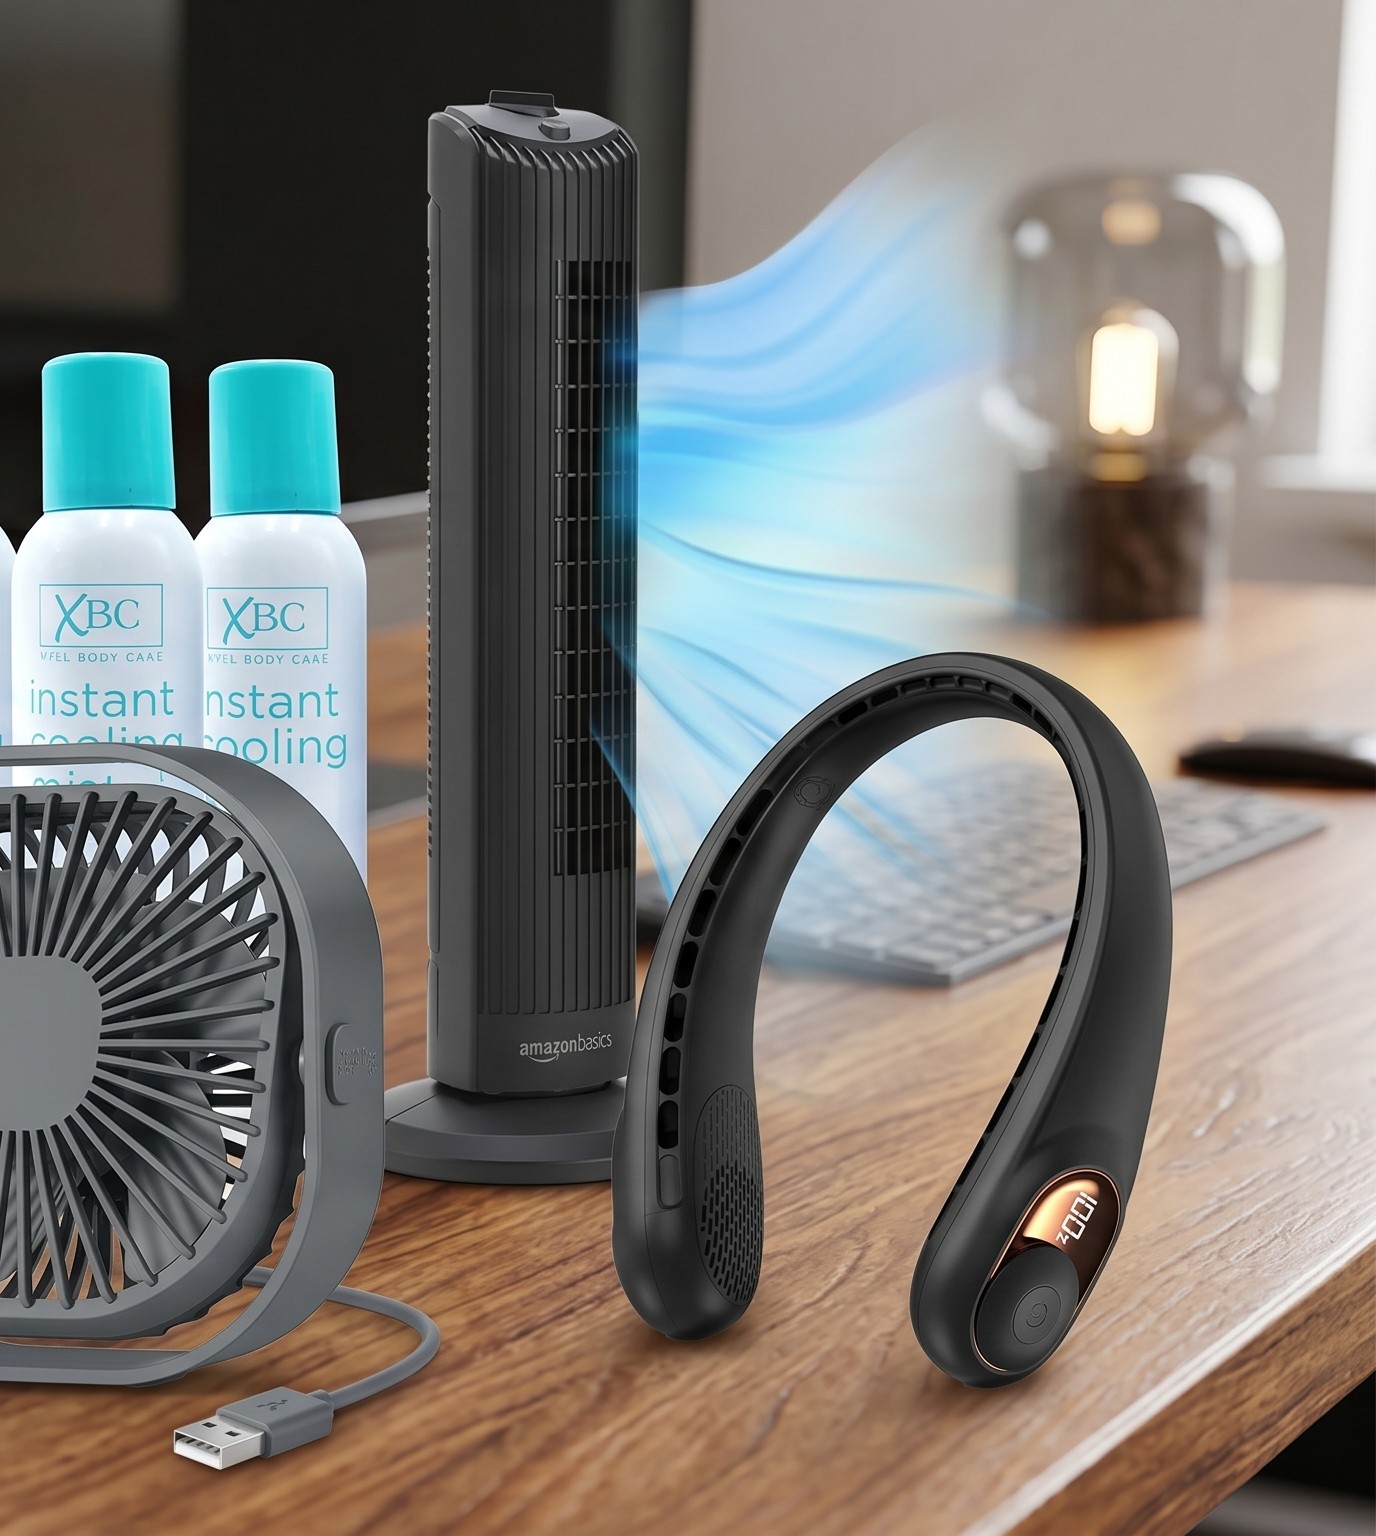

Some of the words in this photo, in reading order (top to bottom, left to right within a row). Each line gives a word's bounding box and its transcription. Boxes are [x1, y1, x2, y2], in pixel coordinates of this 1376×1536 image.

[54, 593, 140, 643] XBC
[222, 596, 305, 646] XBC
[78, 652, 118, 663] BODY
[244, 654, 284, 665] BODY
[30, 679, 174, 718] instant
[206, 683, 339, 719] nstant
[519, 1031, 612, 1057] amazonbasics
